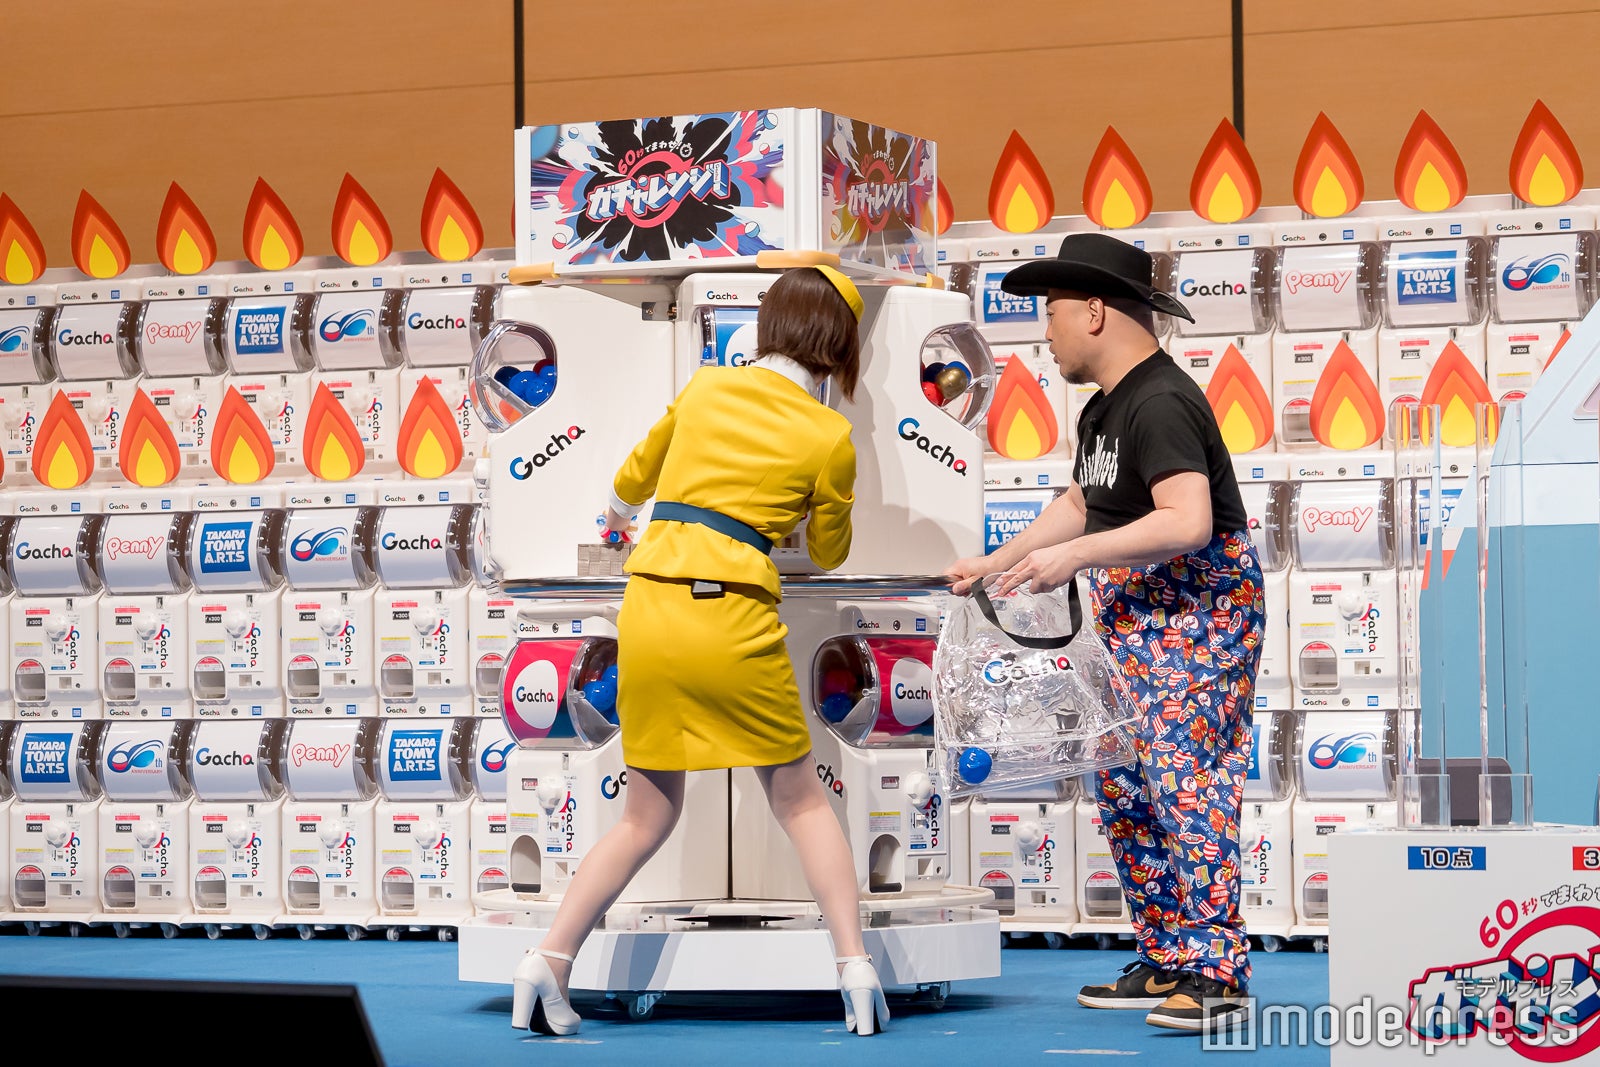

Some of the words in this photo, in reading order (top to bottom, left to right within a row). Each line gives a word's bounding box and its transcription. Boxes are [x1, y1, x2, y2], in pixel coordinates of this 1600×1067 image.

[1286, 270, 1352, 294] Penny
[1402, 269, 1450, 281] TOMY
[706, 291, 738, 300] Gacha
[1180, 279, 1247, 297] Gacha
[240, 323, 279, 334] TOMY
[241, 314, 279, 323] TAKARA
[408, 313, 466, 330] Gacha
[59, 329, 114, 346] Gacha
[146, 322, 201, 344] Penny
[110, 411, 119, 449] Gacha
[197, 409, 207, 446] Gacha
[284, 406, 293, 443] Gacha
[372, 402, 382, 440] Gacha
[462, 400, 472, 438] Gacha
[25, 416, 35, 453] Gacha
[898, 418, 967, 476] Gacha
[510, 426, 585, 480] Gacha
[990, 510, 1036, 520] TAKARA
[1302, 507, 1372, 533] Penny
[204, 540, 244, 551] TOMY
[206, 530, 246, 539] TAKARA
[382, 532, 442, 550] Gacha
[16, 542, 73, 559] Gacha
[107, 537, 164, 560] Penny
[520, 623, 539, 632] Gacha
[857, 620, 880, 628] Gacha
[1368, 608, 1380, 653] Gacha
[70, 630, 79, 669] Gacha
[160, 629, 170, 669] Gacha
[250, 628, 261, 667] Gacha
[345, 625, 355, 665] Gacha
[439, 624, 449, 664] Gacha
[516, 686, 554, 702] Gacha
[27, 742, 65, 751] TAKARA
[393, 748, 436, 758] TOMY
[394, 738, 436, 747] TAKARA
[25, 751, 65, 762] TOMY
[196, 748, 254, 766] Gacha
[292, 743, 350, 768] Penny
[816, 764, 843, 798] cha
[566, 798, 576, 852] Gacha
[931, 794, 941, 848] Gacha
[70, 837, 80, 876] Gacha
[160, 837, 170, 877] Gacha
[251, 837, 261, 877] Gacha
[346, 837, 356, 877] Gacha
[440, 838, 451, 878] Gacha
[1045, 840, 1055, 883] Gacha
[1260, 840, 1271, 884] Gacha
[1422, 848, 1472, 868] 10点
